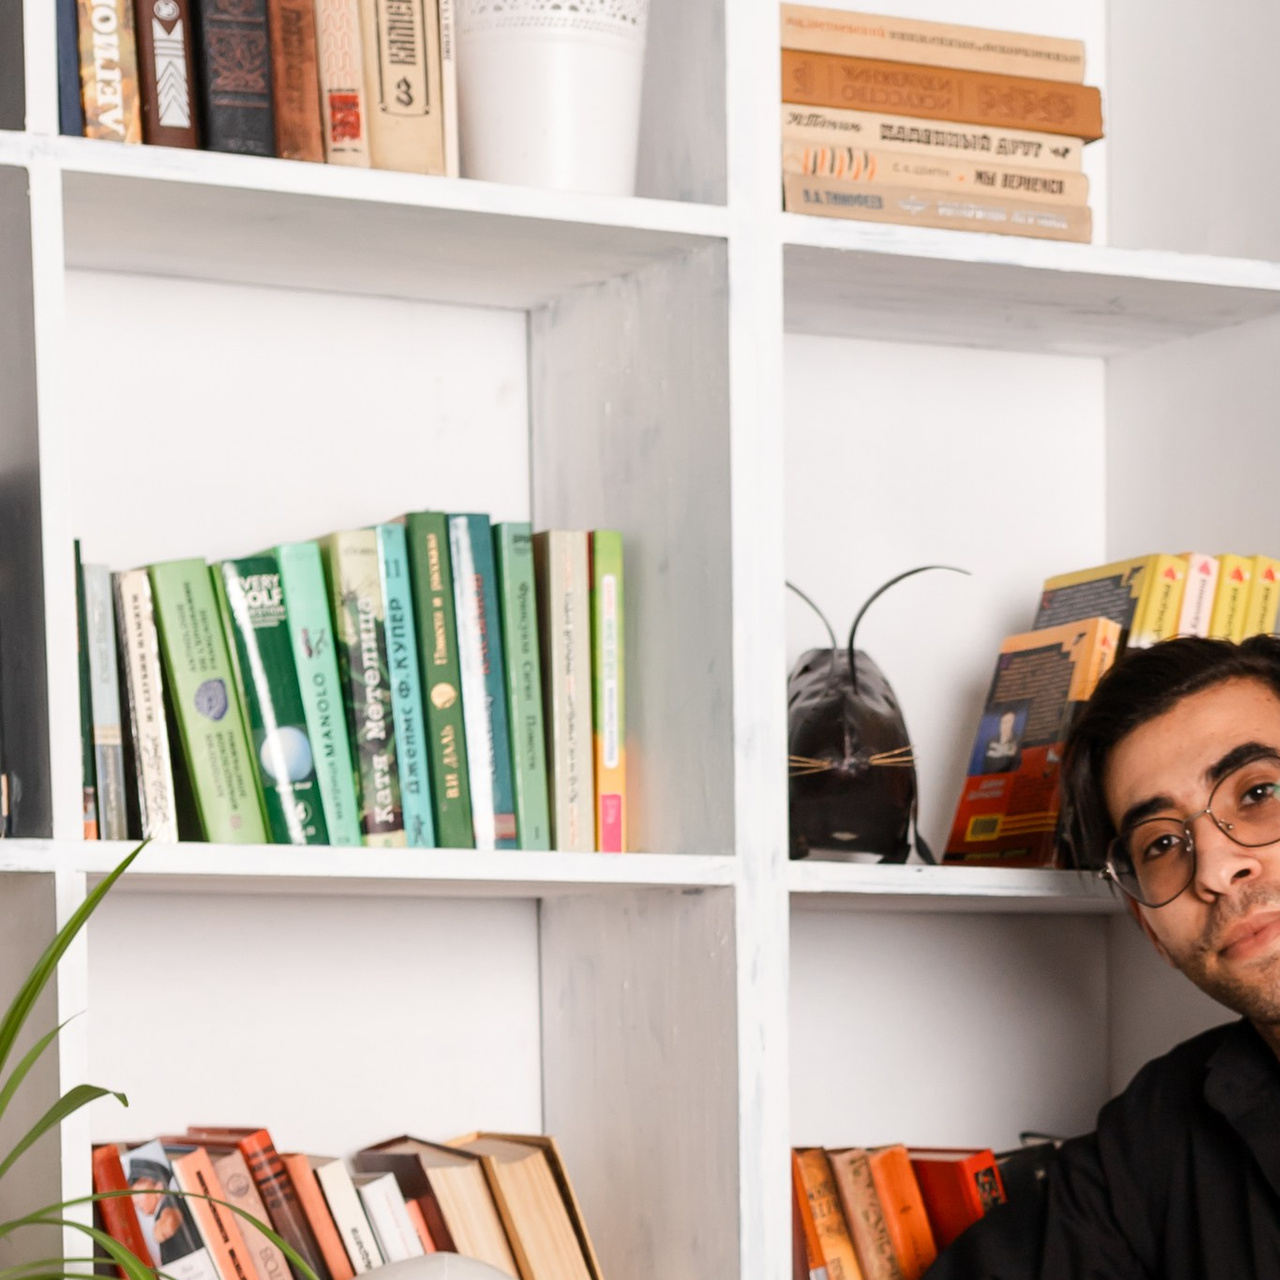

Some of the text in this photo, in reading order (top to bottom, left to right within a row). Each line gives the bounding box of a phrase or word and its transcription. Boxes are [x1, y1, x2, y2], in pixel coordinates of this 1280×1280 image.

[387, 596, 409, 669] КУПЕР
[310, 671, 338, 758] MANOLO
[350, 595, 396, 824] Катя Метелица
